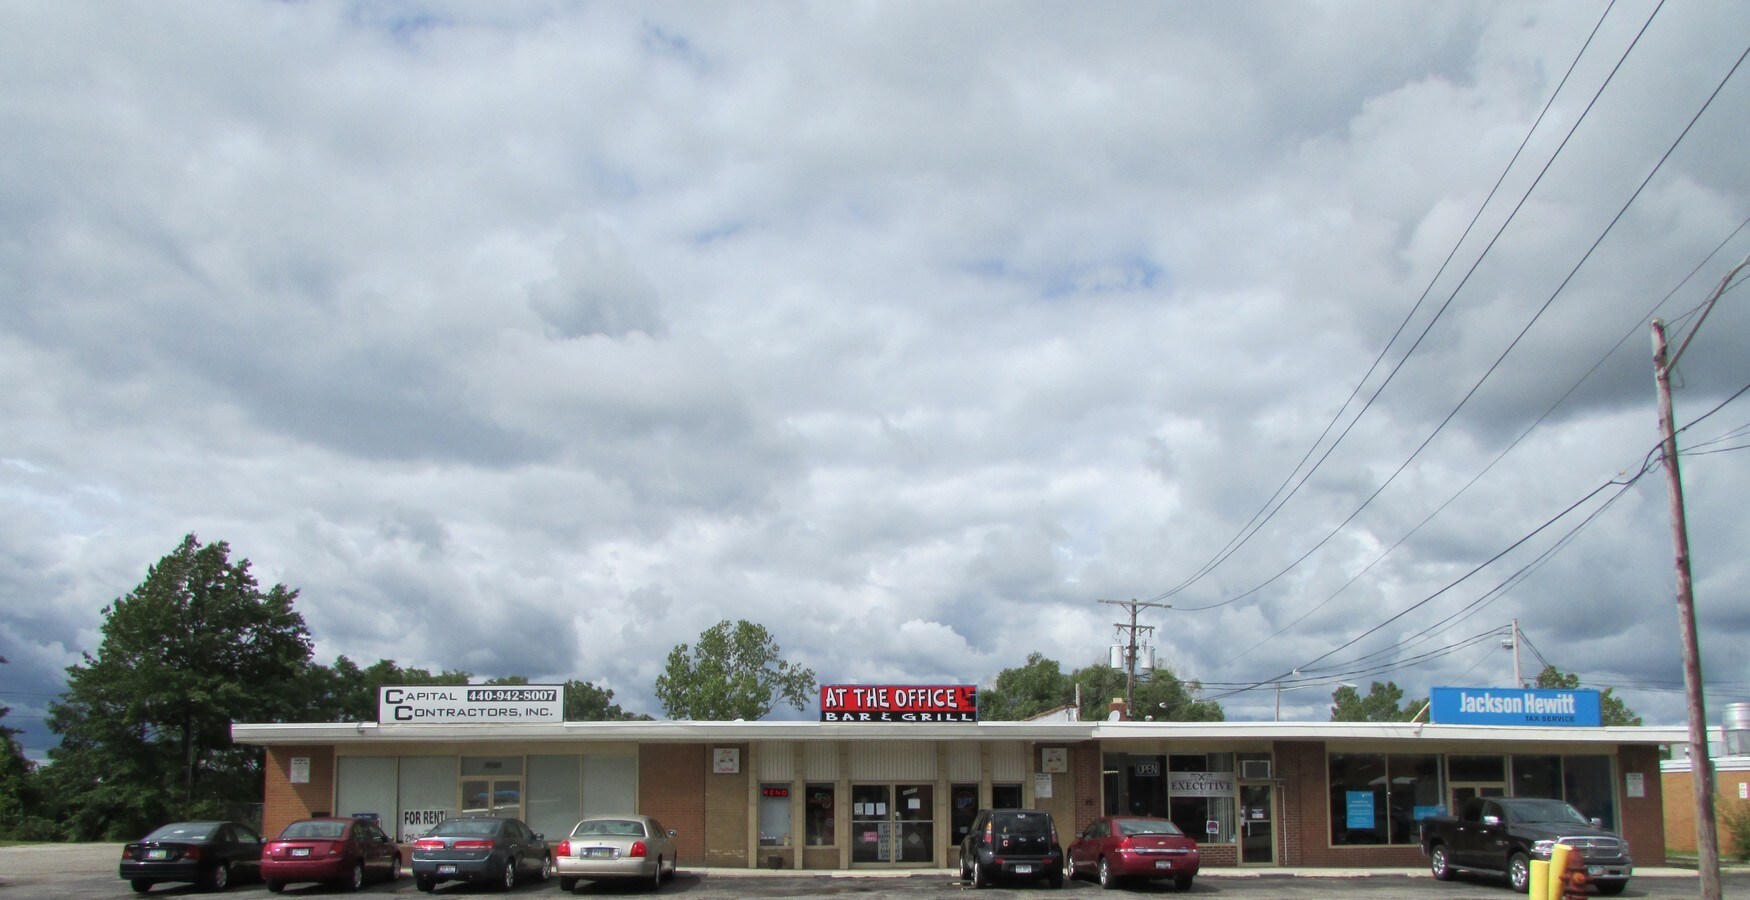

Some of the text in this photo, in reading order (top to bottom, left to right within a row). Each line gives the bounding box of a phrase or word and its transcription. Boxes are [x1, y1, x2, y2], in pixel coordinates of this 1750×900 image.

[385, 689, 458, 704] CAPITAL
[468, 690, 556, 701] 440-942-8007
[826, 688, 957, 708] AT THE OFFICE
[1460, 692, 1575, 714] Jackson Hewitt
[394, 706, 553, 721] CONTRACTORS, INC.
[825, 712, 871, 721] BAR
[902, 713, 973, 721] GRILL
[1137, 763, 1158, 774] OPEN
[1171, 782, 1232, 791] EXECUTIVE
[404, 811, 444, 824] FOR RENT
